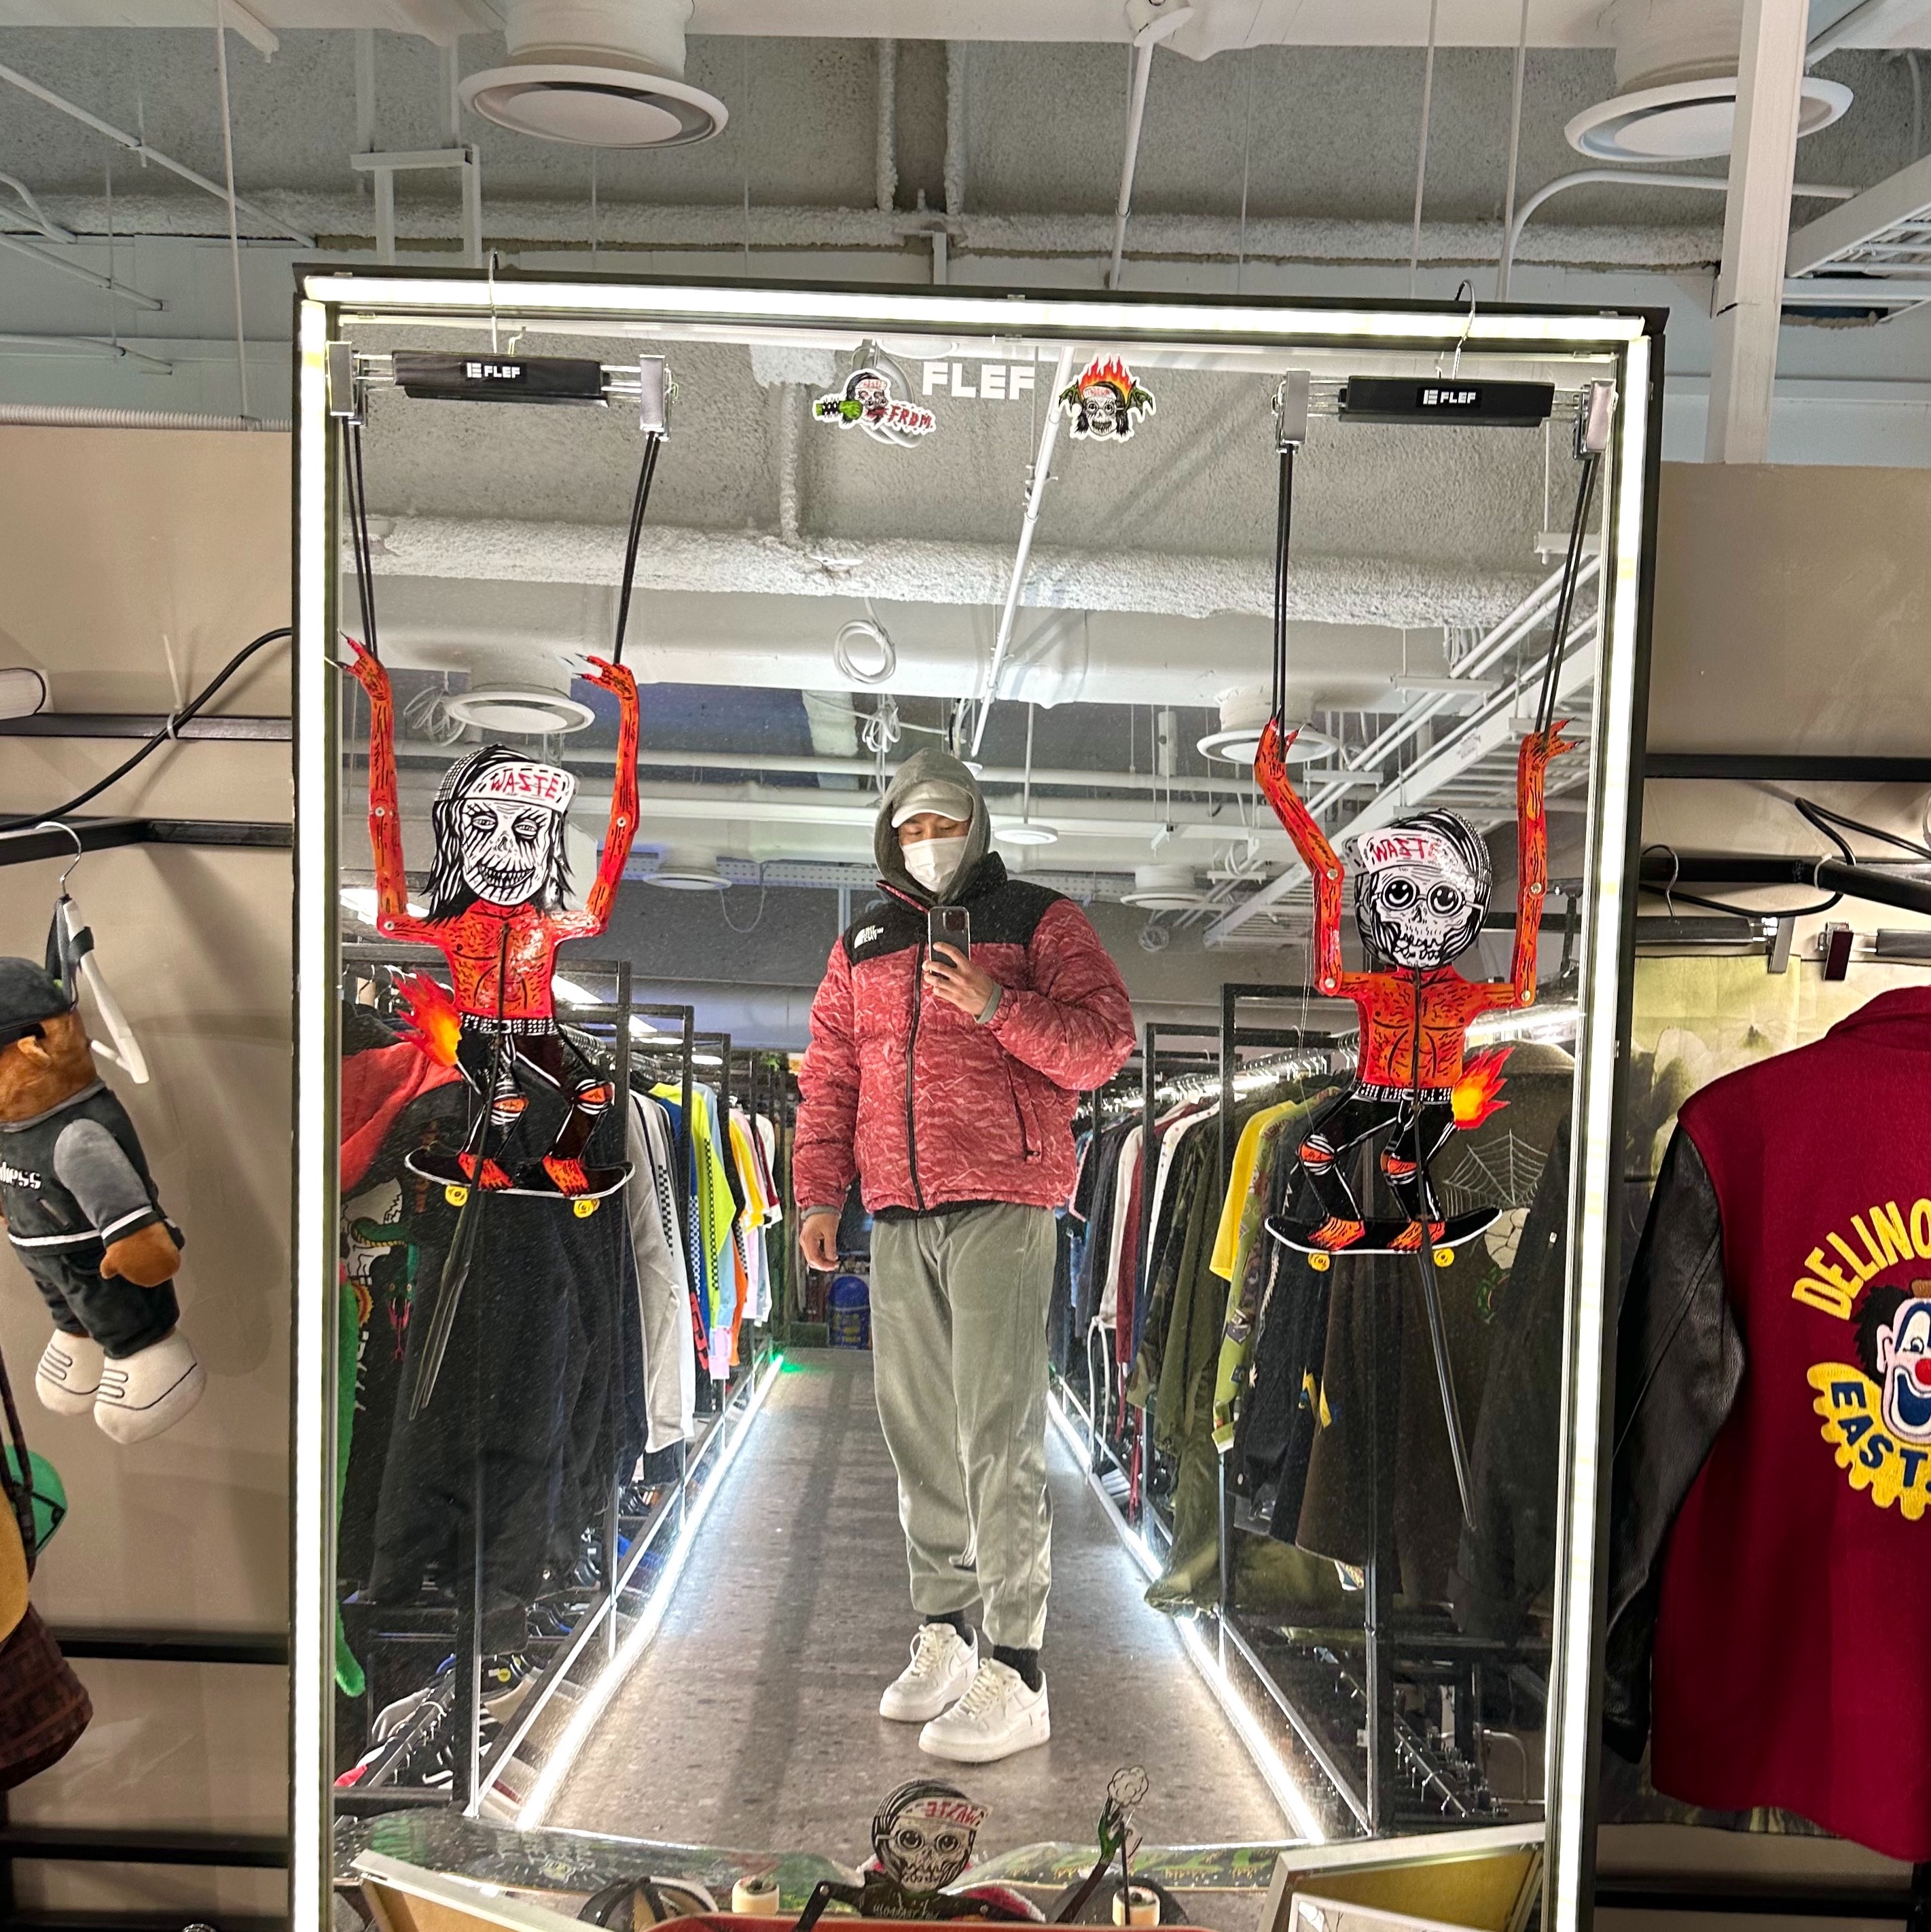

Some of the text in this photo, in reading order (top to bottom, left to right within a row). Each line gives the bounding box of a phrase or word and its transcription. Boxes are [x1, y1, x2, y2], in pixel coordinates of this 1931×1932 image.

[484, 365, 520, 378] FLEF
[922, 361, 1035, 400] FLEF
[1440, 391, 1476, 404] FLEF
[490, 769, 558, 799] WASTE
